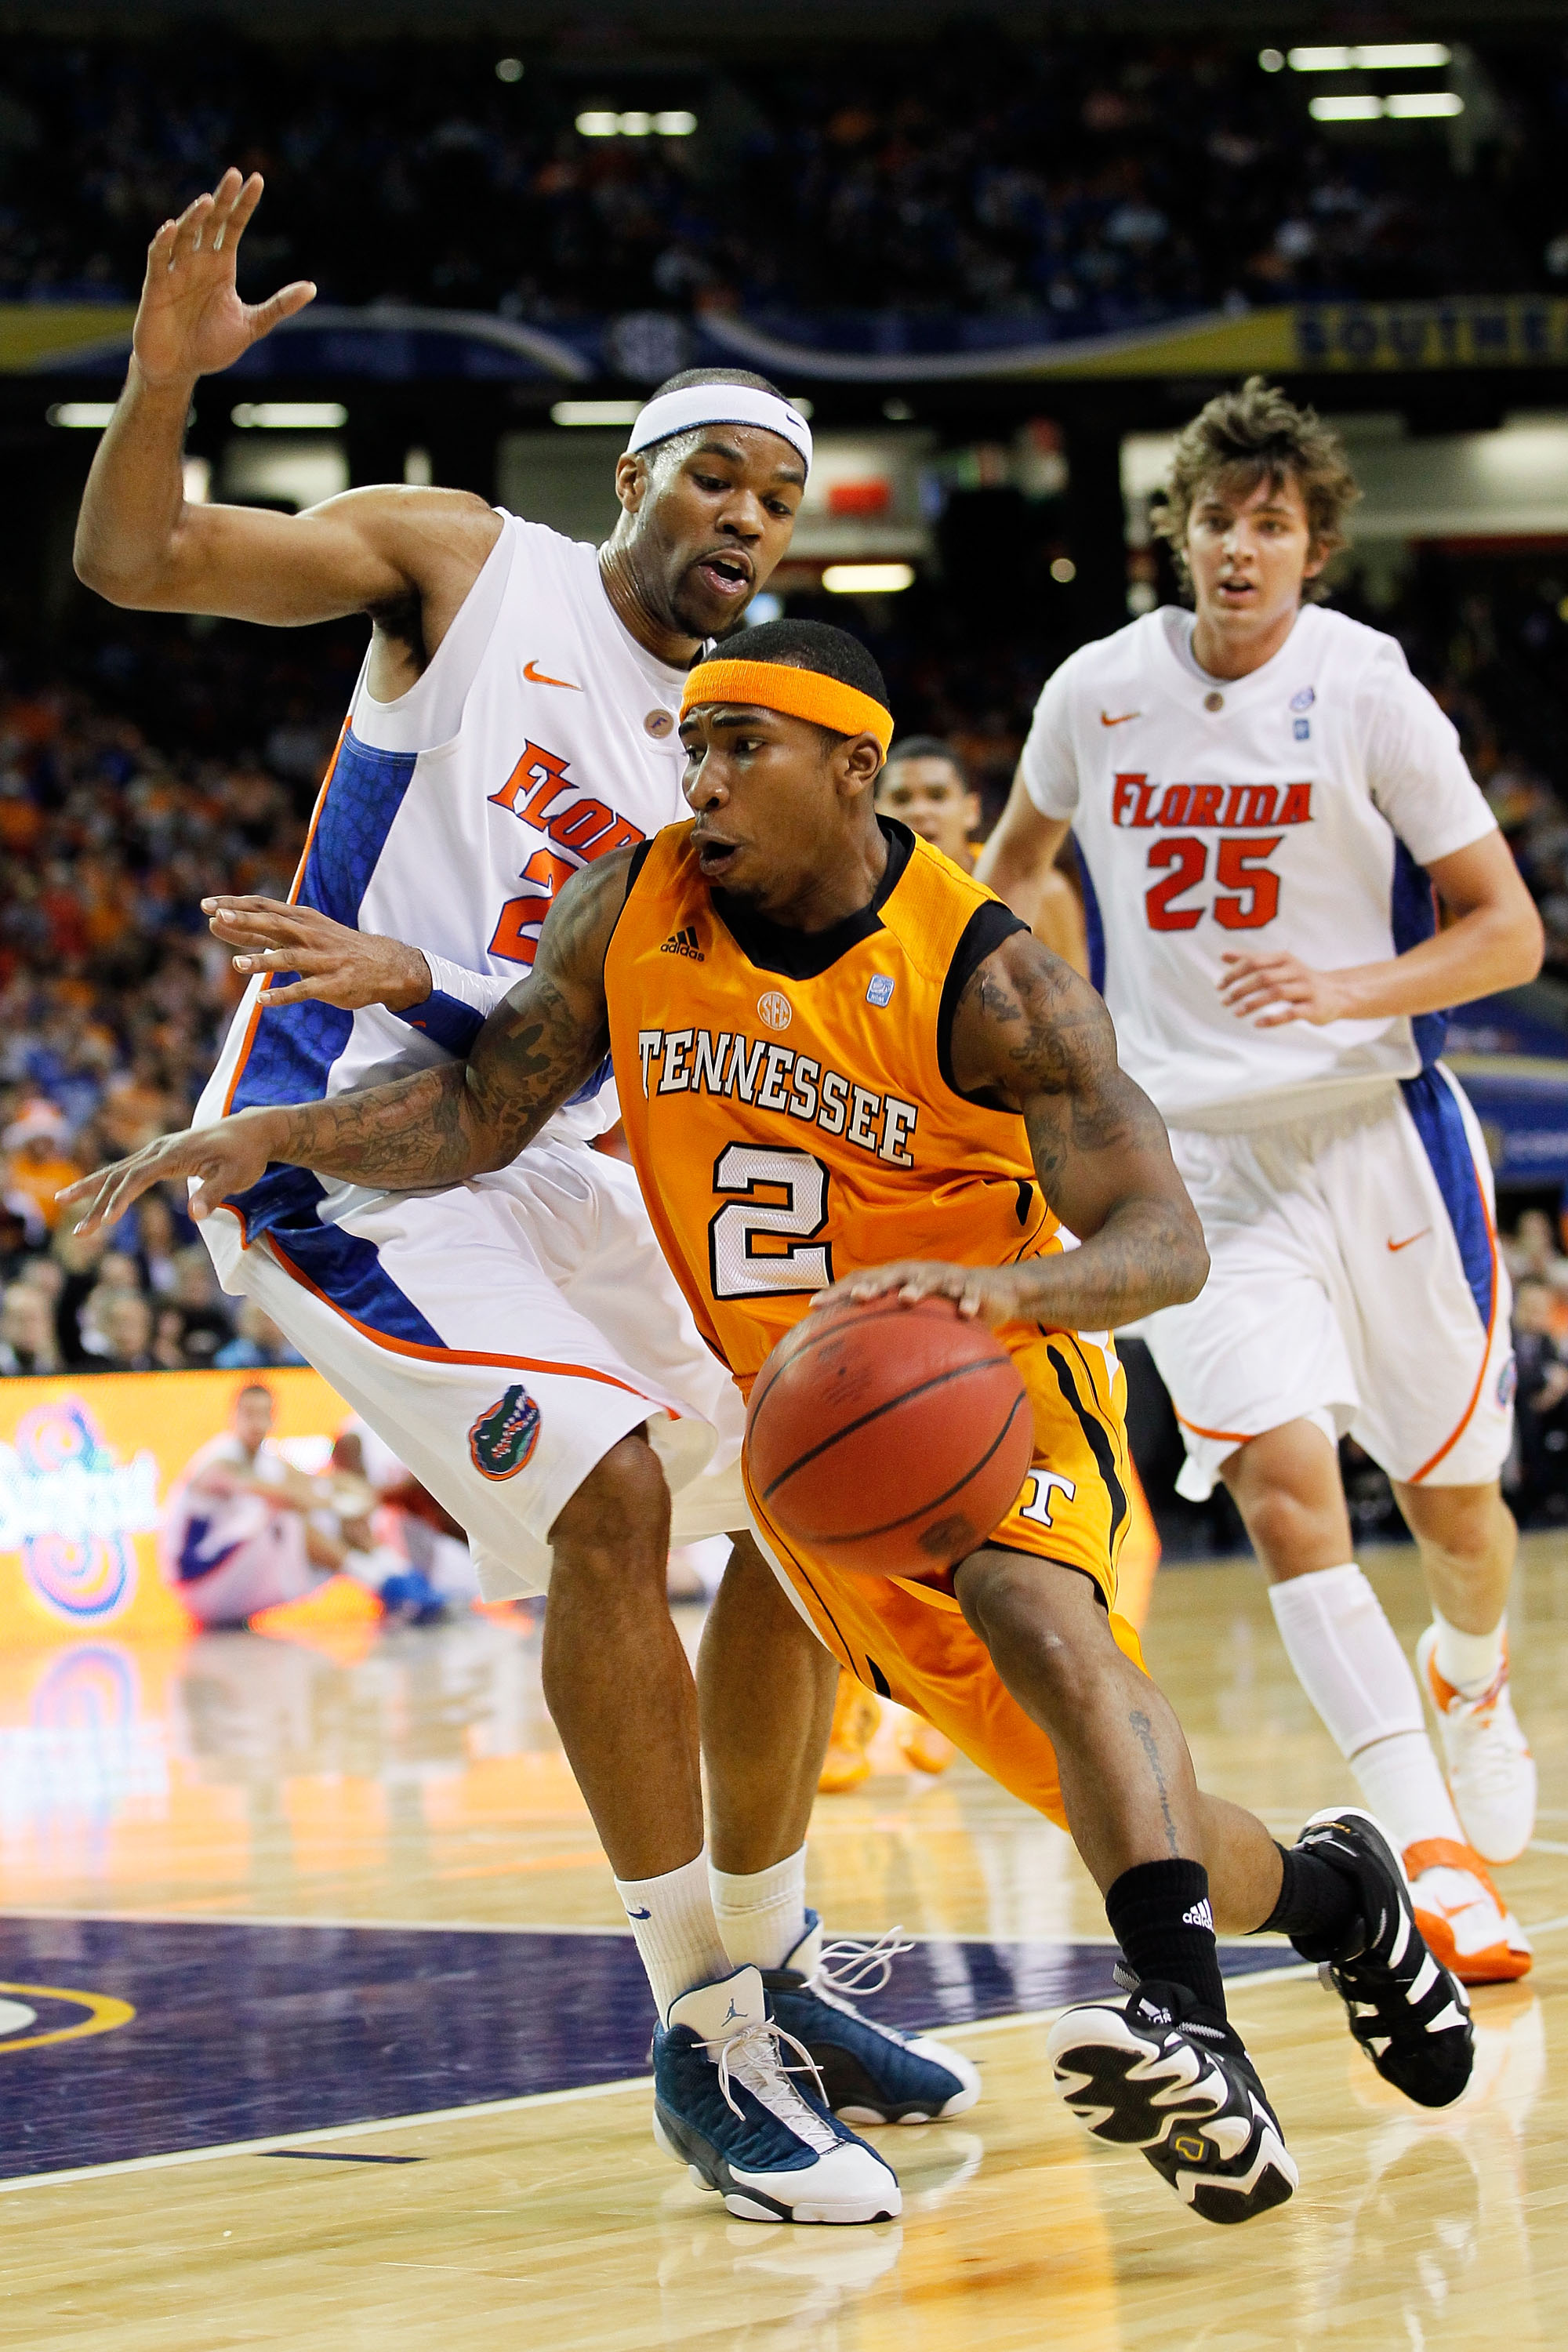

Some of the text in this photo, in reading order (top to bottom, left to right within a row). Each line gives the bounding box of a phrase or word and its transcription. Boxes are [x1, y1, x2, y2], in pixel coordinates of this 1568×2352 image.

[1111, 771, 1315, 828] FLORIDA
[1143, 835, 1286, 932] 25
[660, 942, 705, 963] adidas
[760, 993, 789, 1029] SEC
[637, 1028, 919, 1169] TENNESSEE
[707, 1140, 836, 1300] 2
[1019, 1467, 1076, 1528] T
